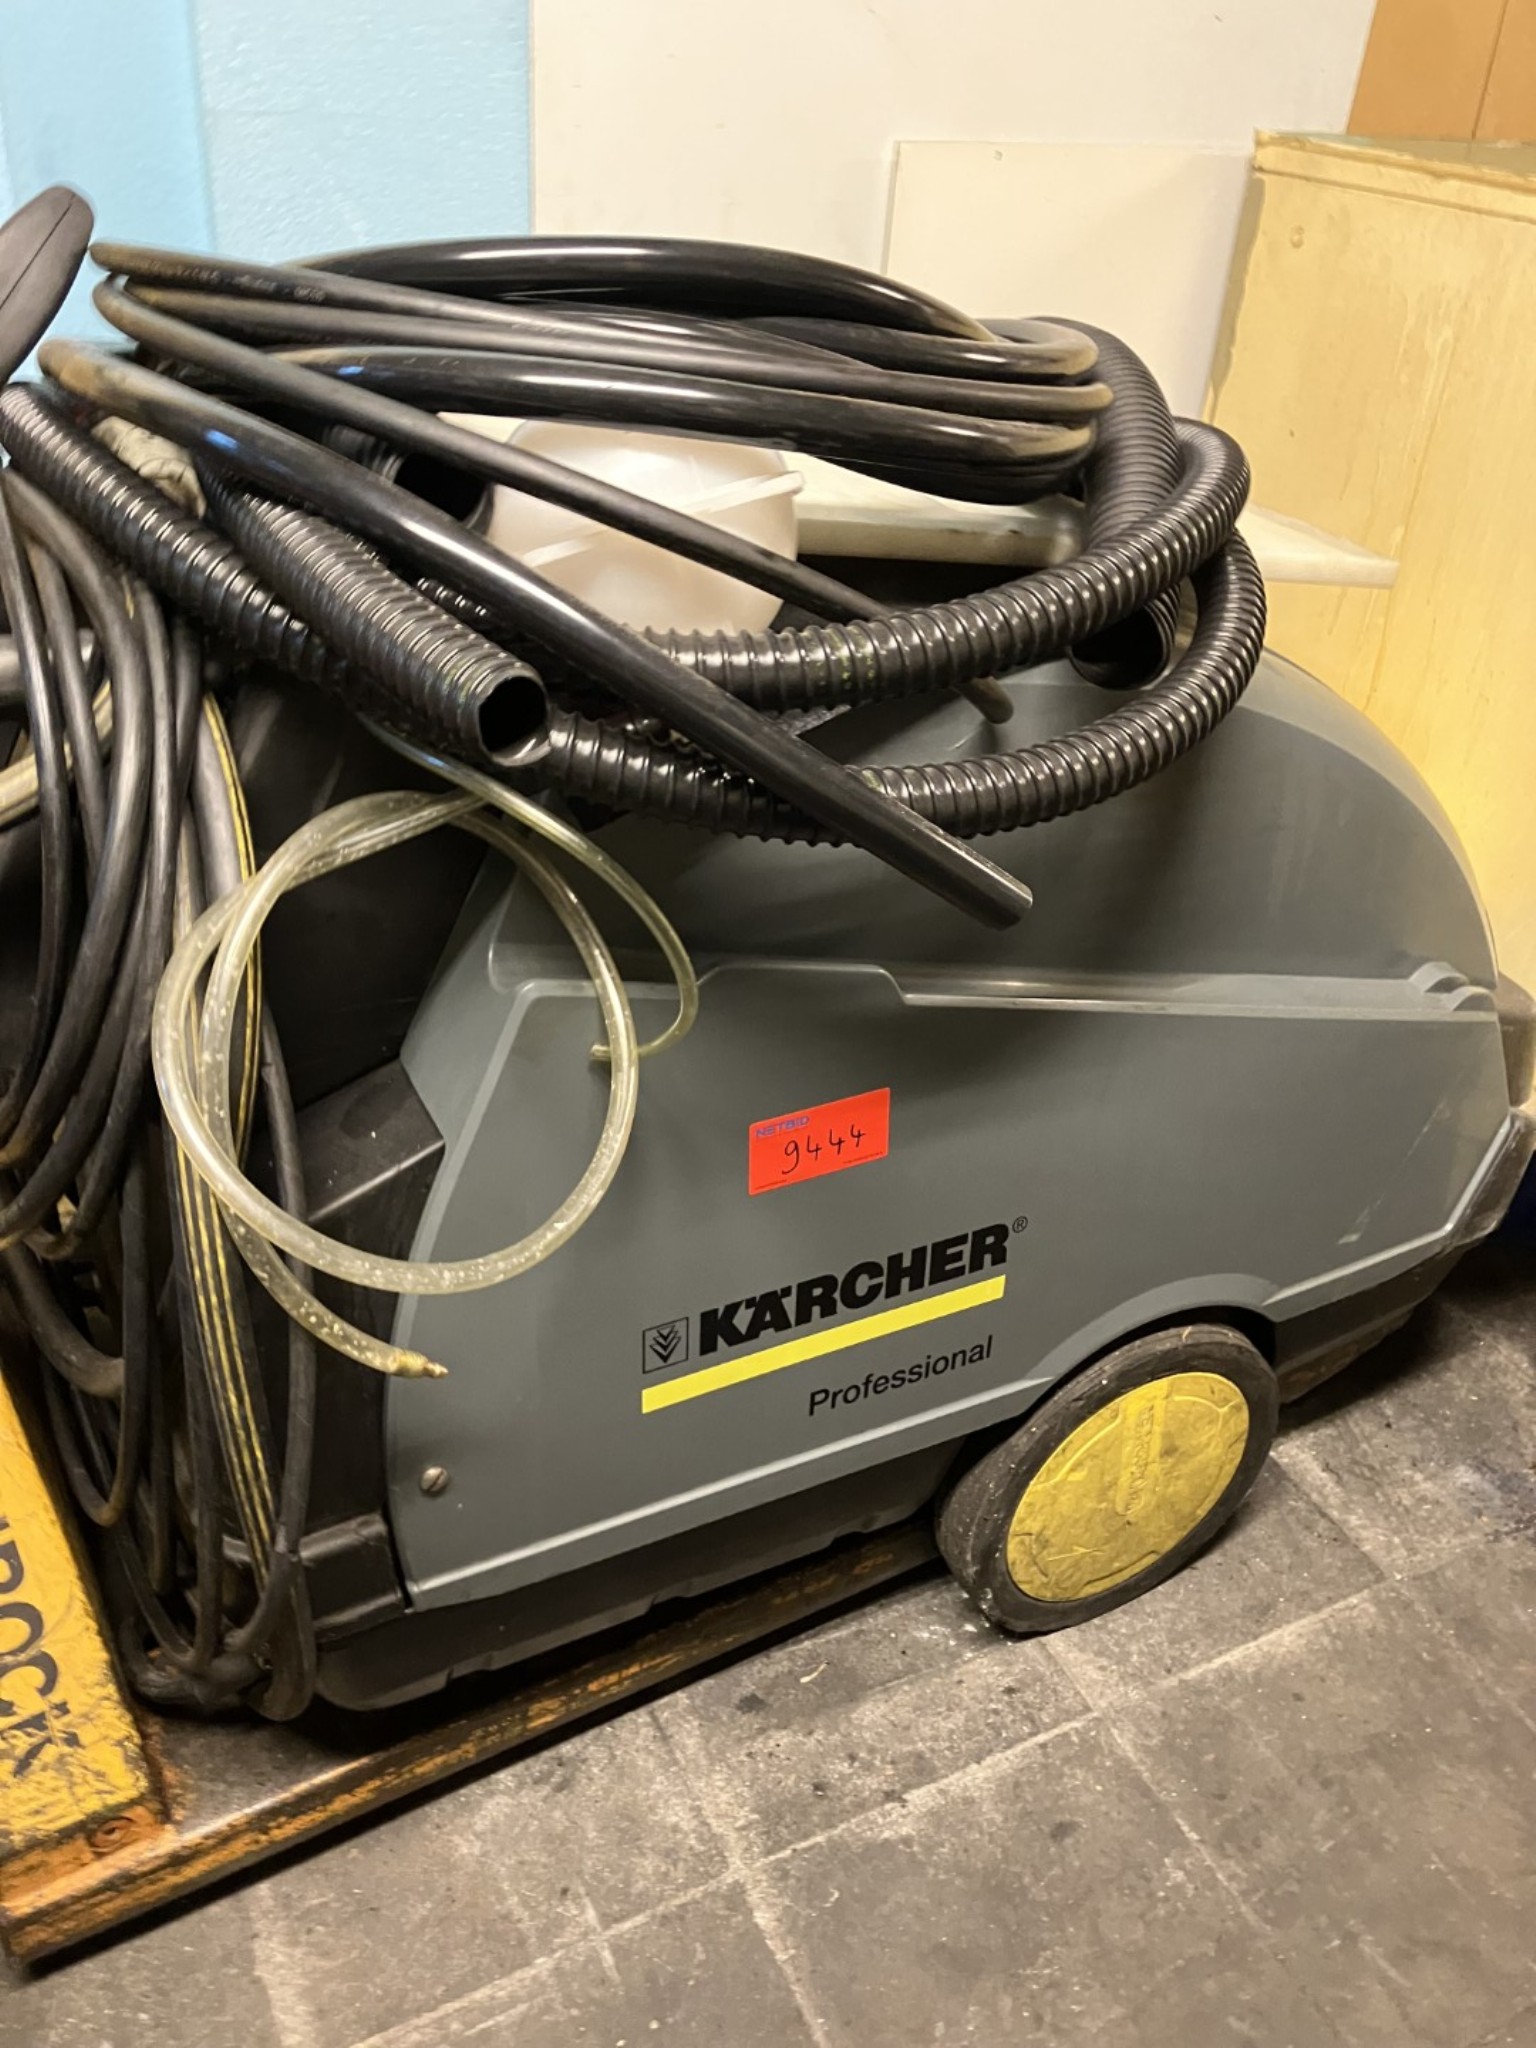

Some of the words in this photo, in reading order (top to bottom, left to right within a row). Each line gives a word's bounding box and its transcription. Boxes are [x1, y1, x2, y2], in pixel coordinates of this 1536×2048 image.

[756, 1115, 810, 1138] NETBID
[781, 1123, 867, 1175] 9444
[808, 1335, 993, 1417] Professional
